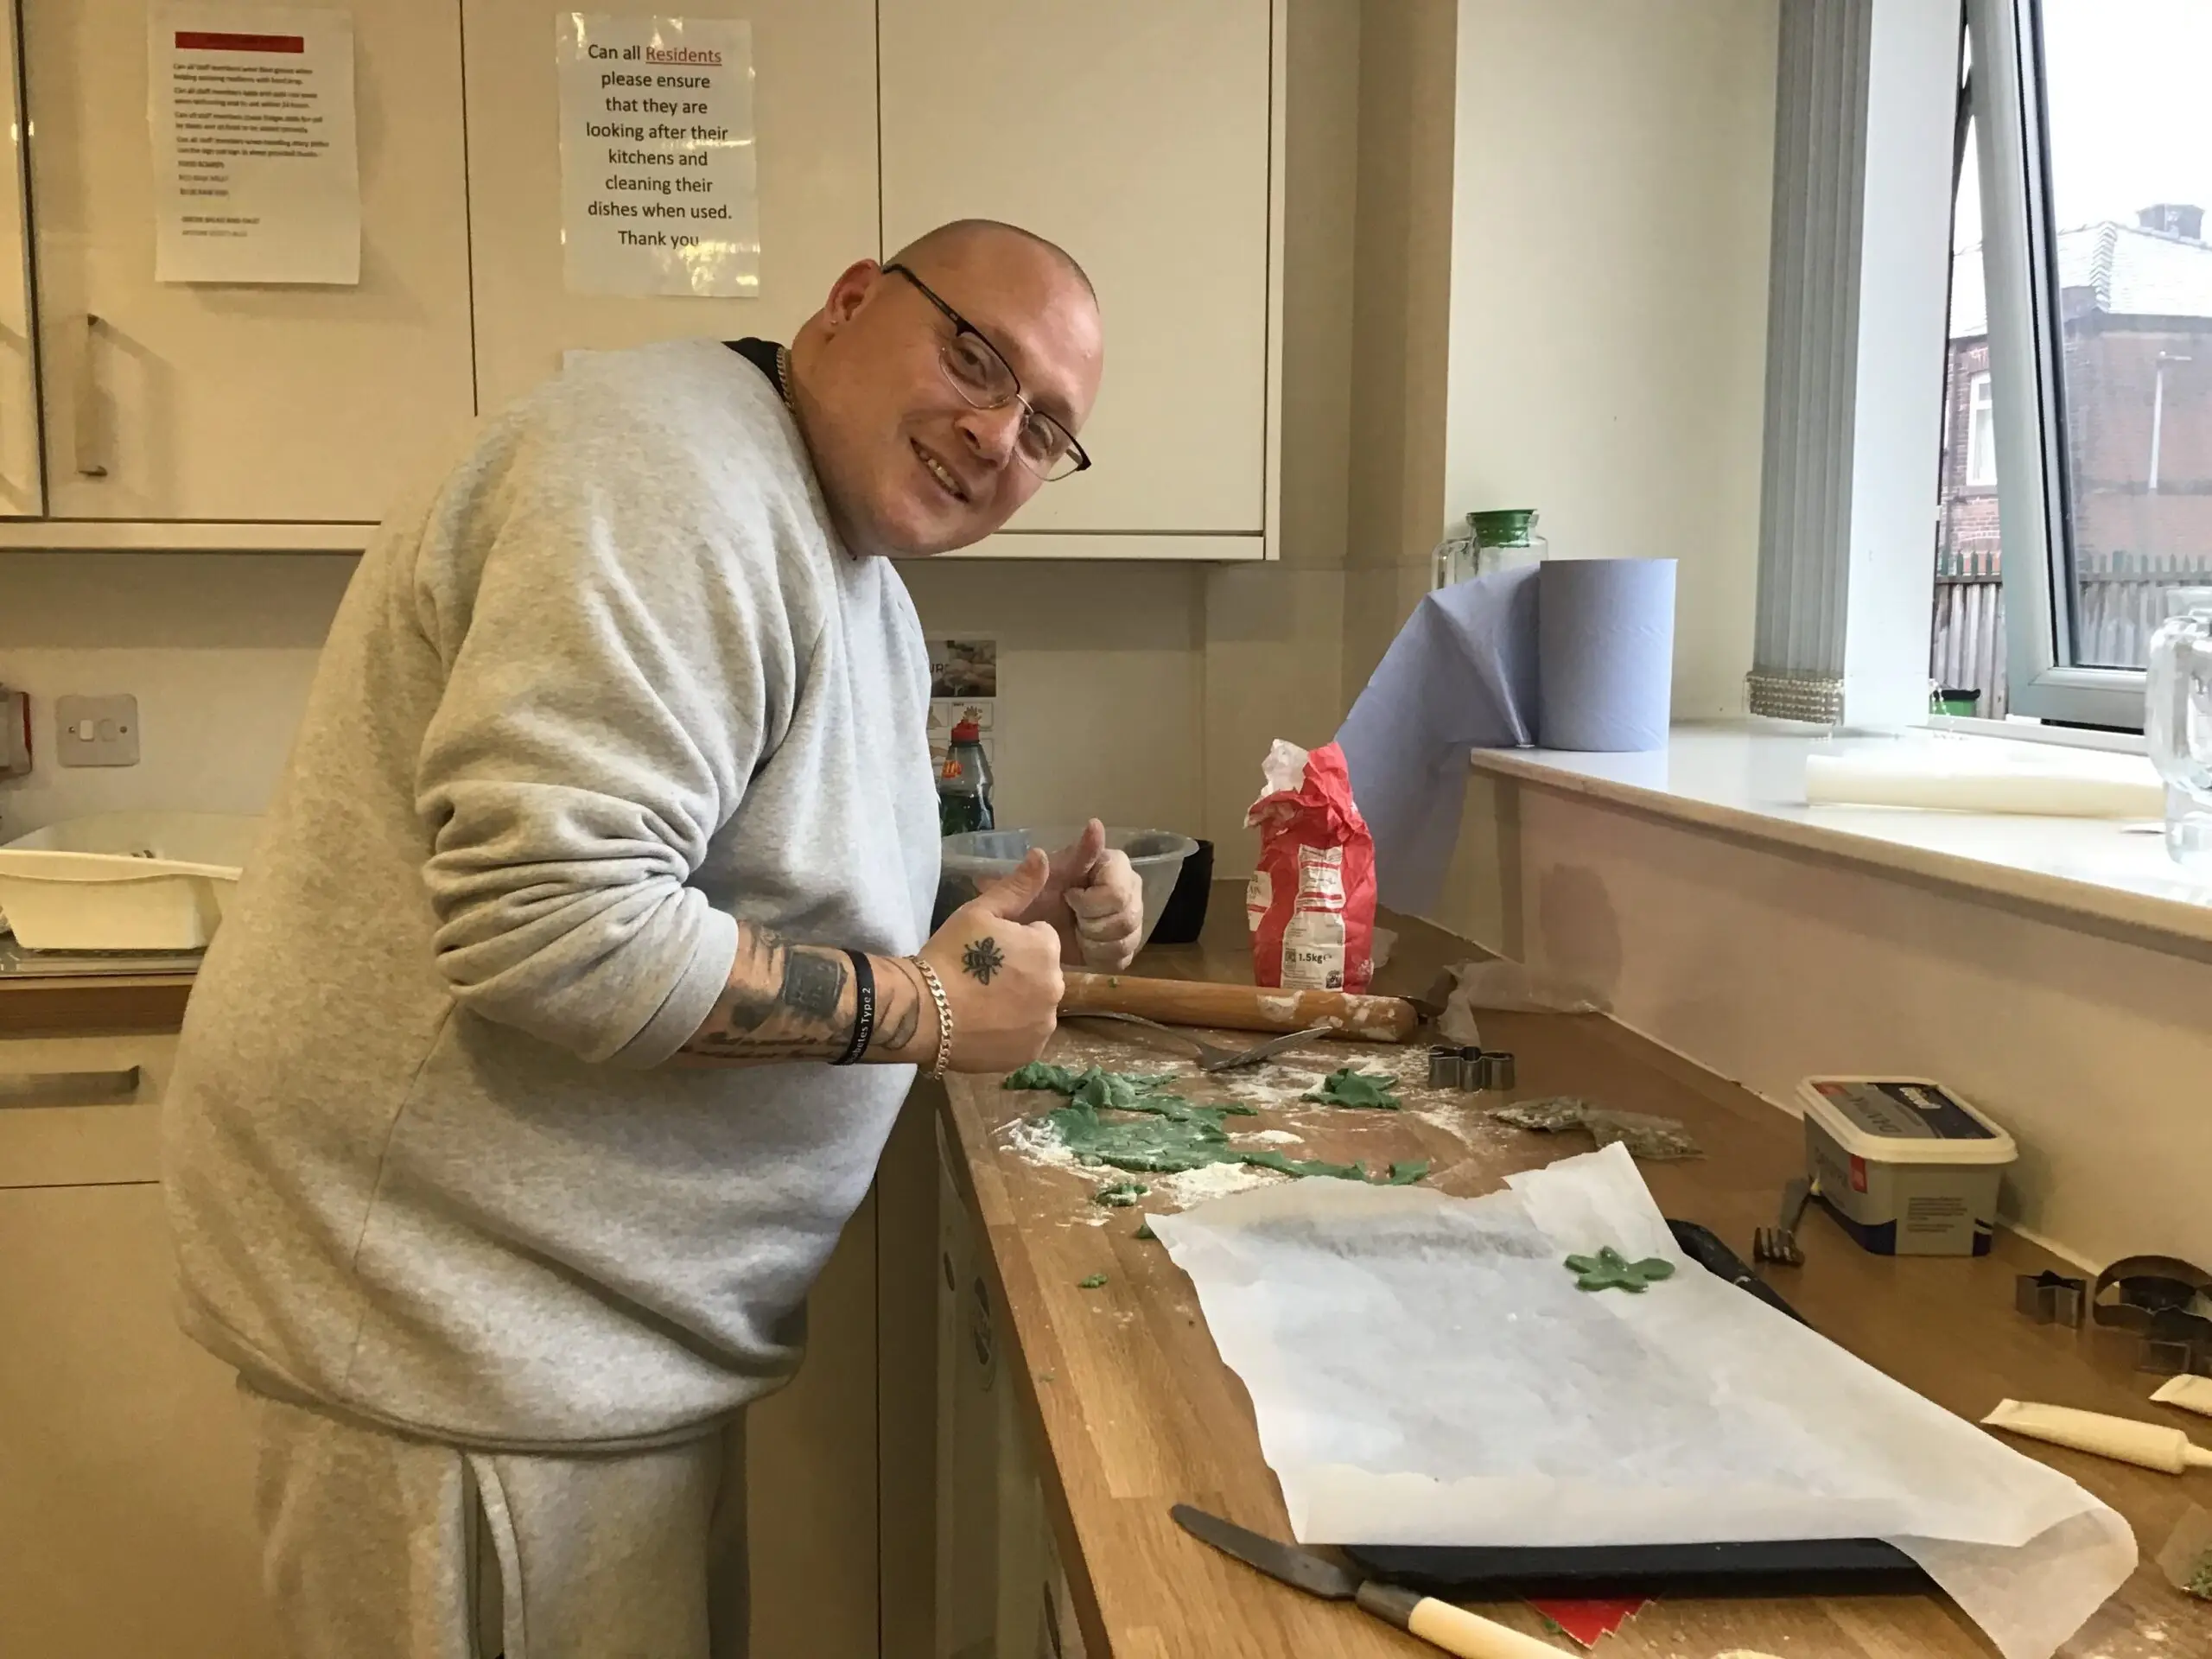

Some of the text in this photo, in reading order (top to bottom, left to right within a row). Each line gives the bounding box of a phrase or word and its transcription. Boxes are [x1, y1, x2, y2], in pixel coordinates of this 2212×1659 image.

[588, 44, 722, 64] Can all Residents
[601, 72, 710, 89] please ensure
[606, 98, 708, 117] that they are
[586, 122, 728, 141] looking after their
[608, 149, 708, 166] kitchens and
[605, 175, 713, 194] cleaning their
[588, 200, 733, 219] dishes when used.
[618, 230, 700, 250] Thank you
[1299, 952, 1323, 964] 1.5kg
[861, 997, 874, 1025] Type
